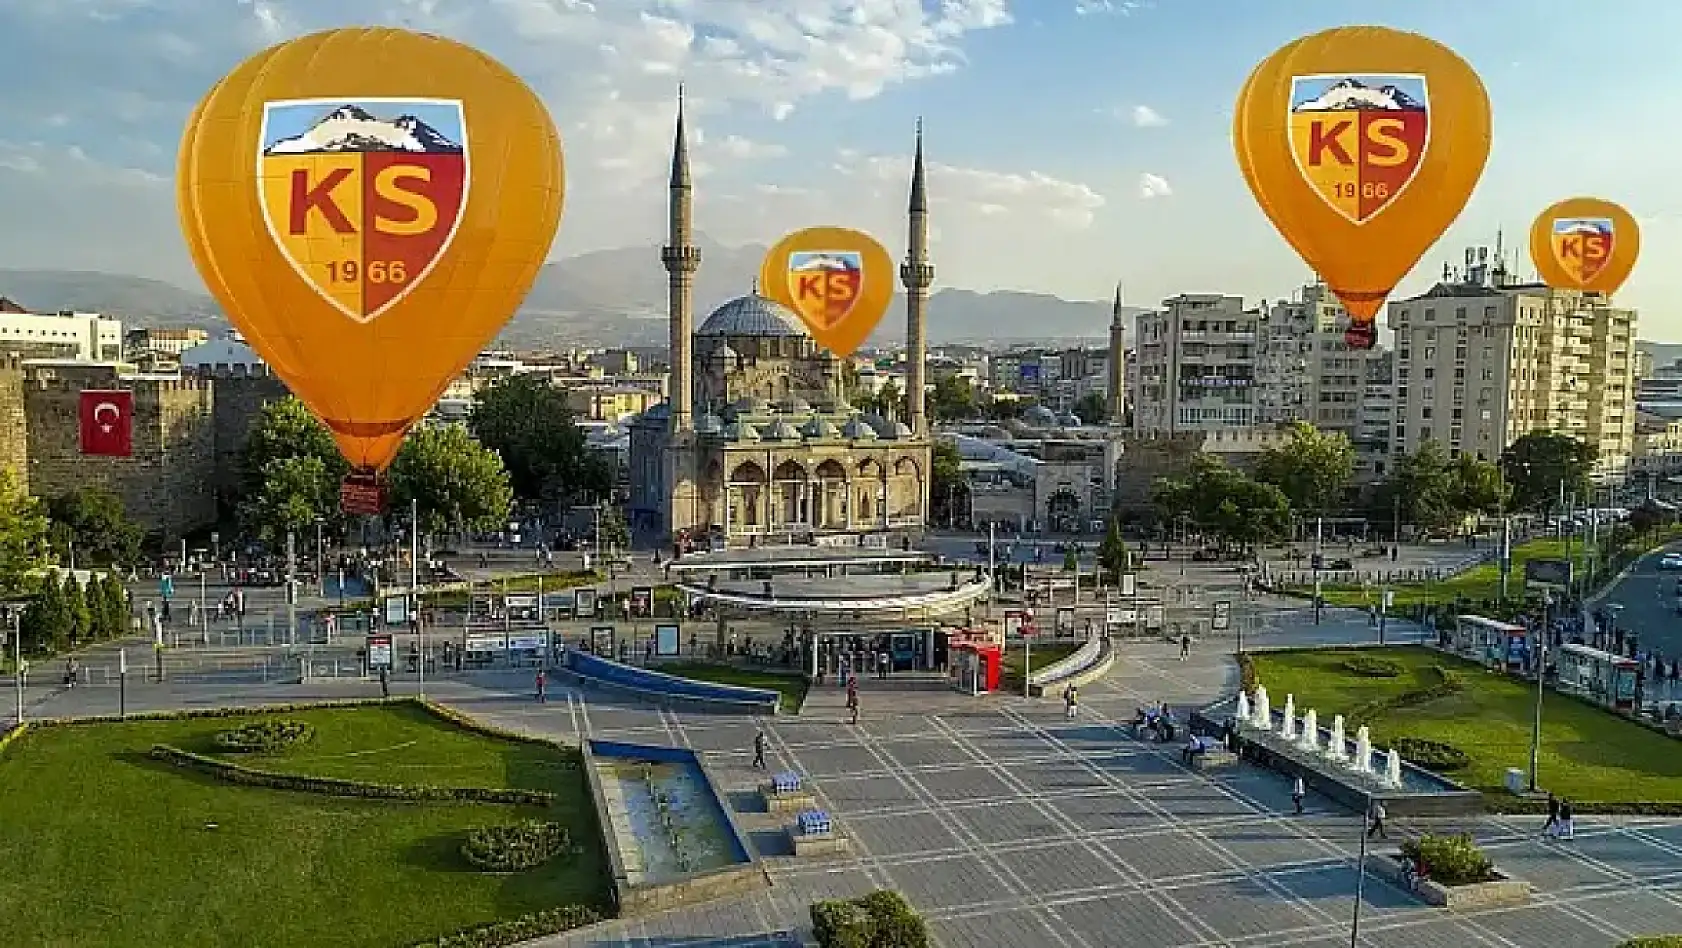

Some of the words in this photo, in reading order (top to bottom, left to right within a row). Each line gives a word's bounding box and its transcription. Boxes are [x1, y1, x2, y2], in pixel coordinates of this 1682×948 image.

[1308, 118, 1410, 167] KS
[290, 164, 438, 235] KS
[1561, 237, 1605, 258] KS
[799, 274, 854, 300] KS
